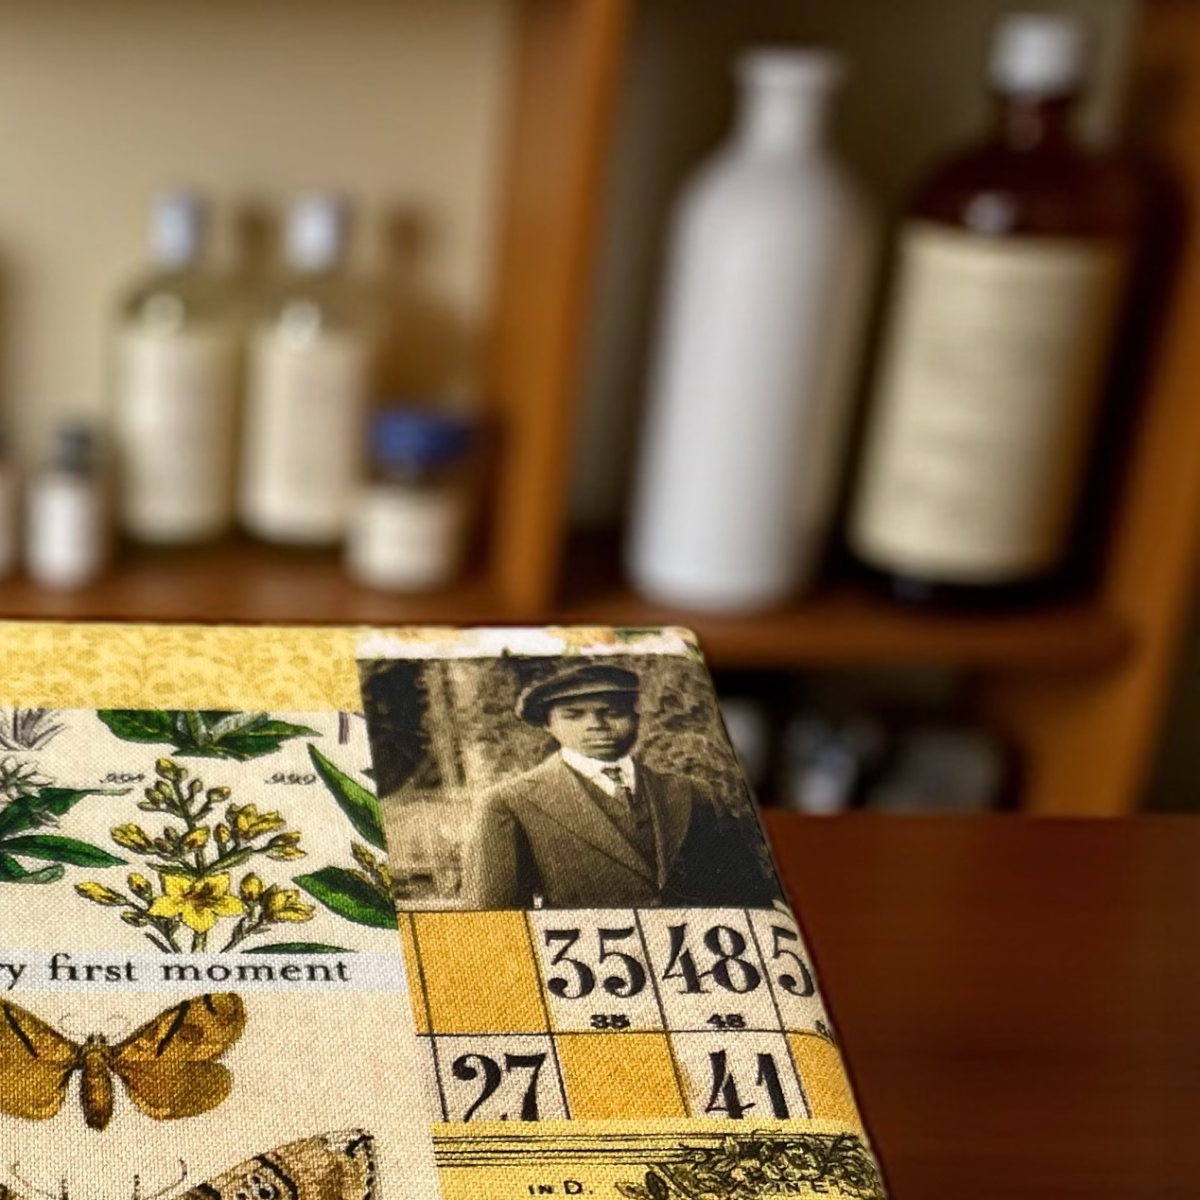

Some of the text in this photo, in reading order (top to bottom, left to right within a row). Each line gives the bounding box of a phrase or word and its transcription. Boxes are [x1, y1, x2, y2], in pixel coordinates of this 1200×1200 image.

[49, 953, 139, 982] first
[160, 959, 352, 982] moment
[545, 924, 647, 999] 35
[662, 922, 762, 996] 48
[590, 1013, 745, 1029] 35 48
[451, 1049, 792, 1121] 27 41
